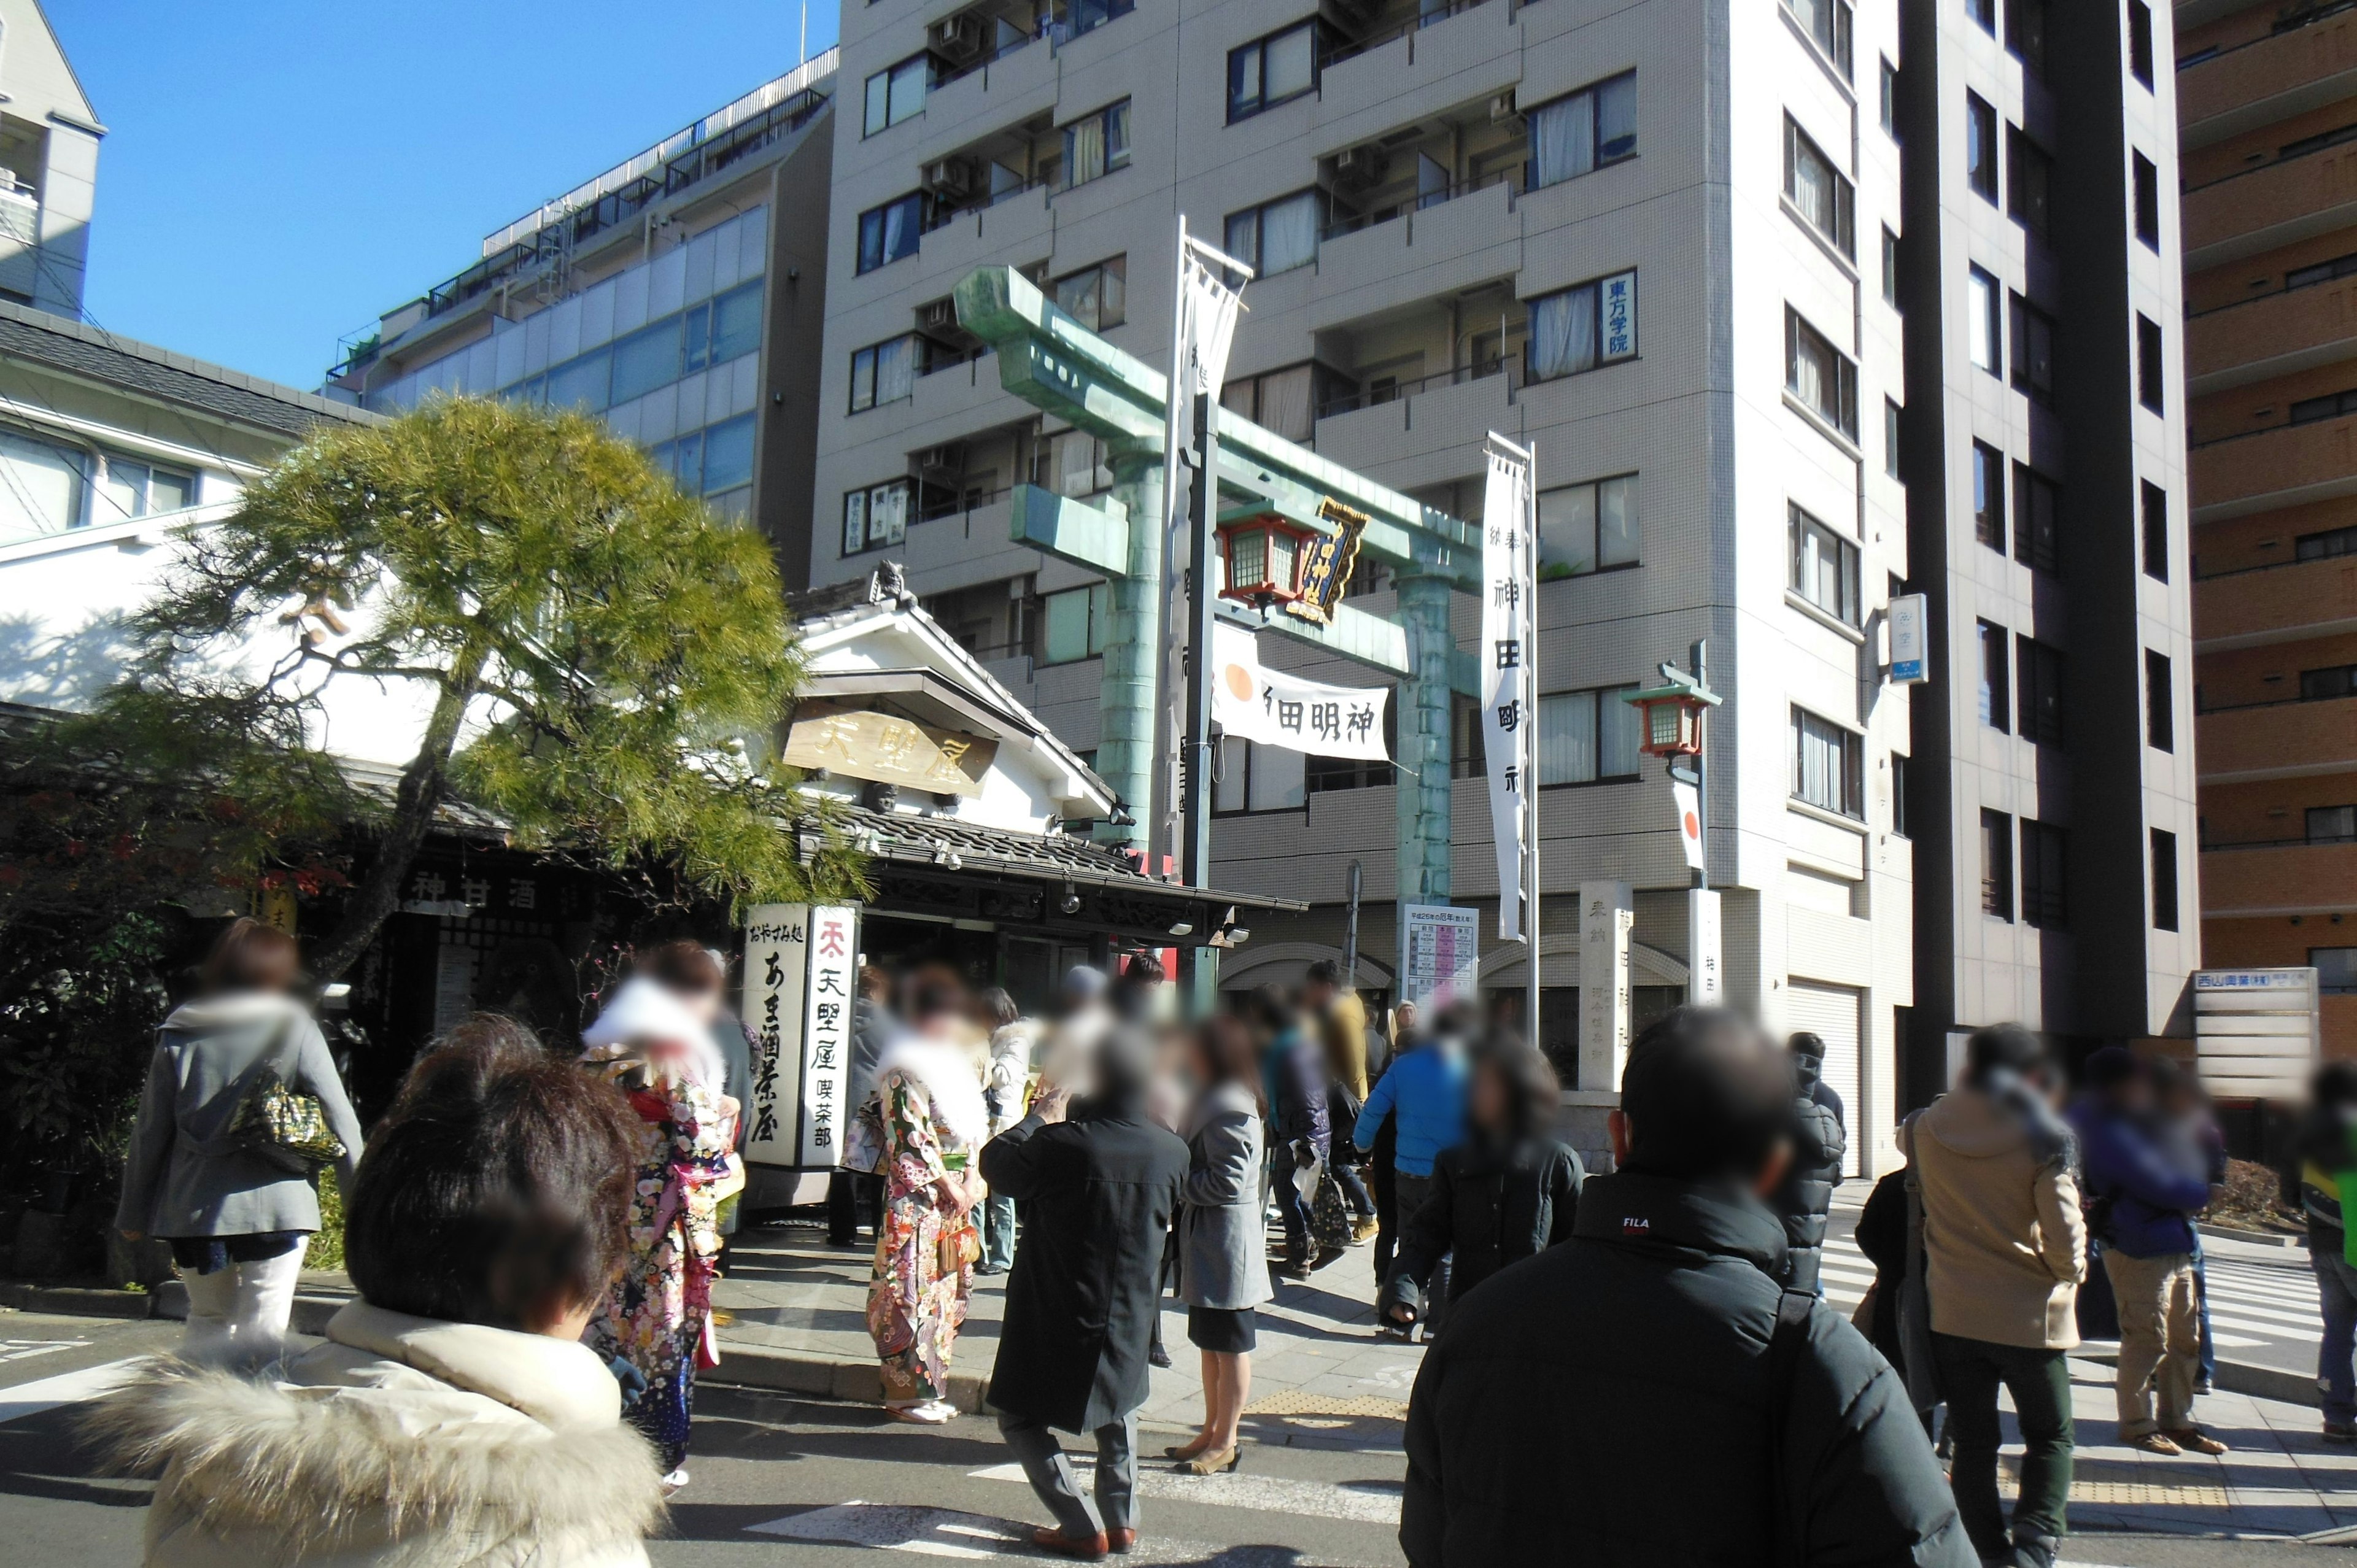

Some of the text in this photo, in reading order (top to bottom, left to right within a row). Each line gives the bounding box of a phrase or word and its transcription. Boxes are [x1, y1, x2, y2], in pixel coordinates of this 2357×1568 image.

[1609, 280, 1628, 355] 東方学院
[814, 715, 971, 784] 天野屋
[814, 1079, 834, 1148] 喫茶部
[1624, 1218, 1649, 1228] FILA
